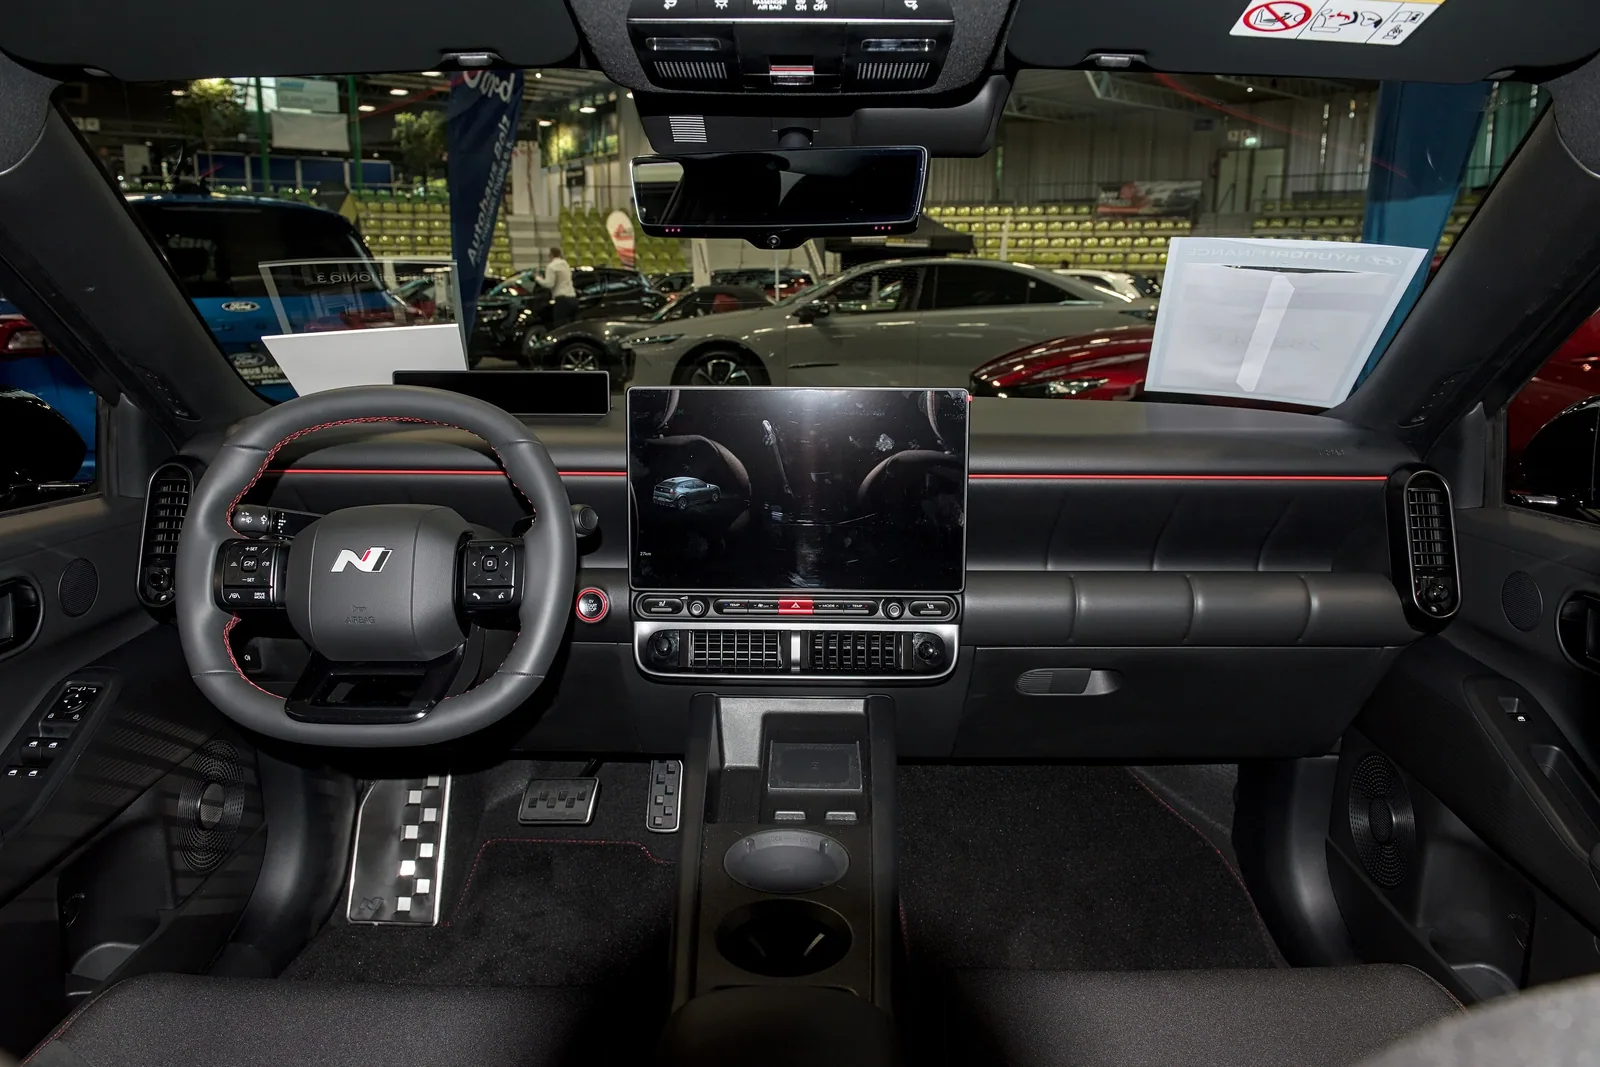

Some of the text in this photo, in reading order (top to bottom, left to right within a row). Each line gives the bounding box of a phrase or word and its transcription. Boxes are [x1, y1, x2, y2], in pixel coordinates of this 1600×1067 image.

[794, 3, 808, 11] ON
[812, 3, 828, 11] OFF
[344, 614, 376, 625] AIRBAG
